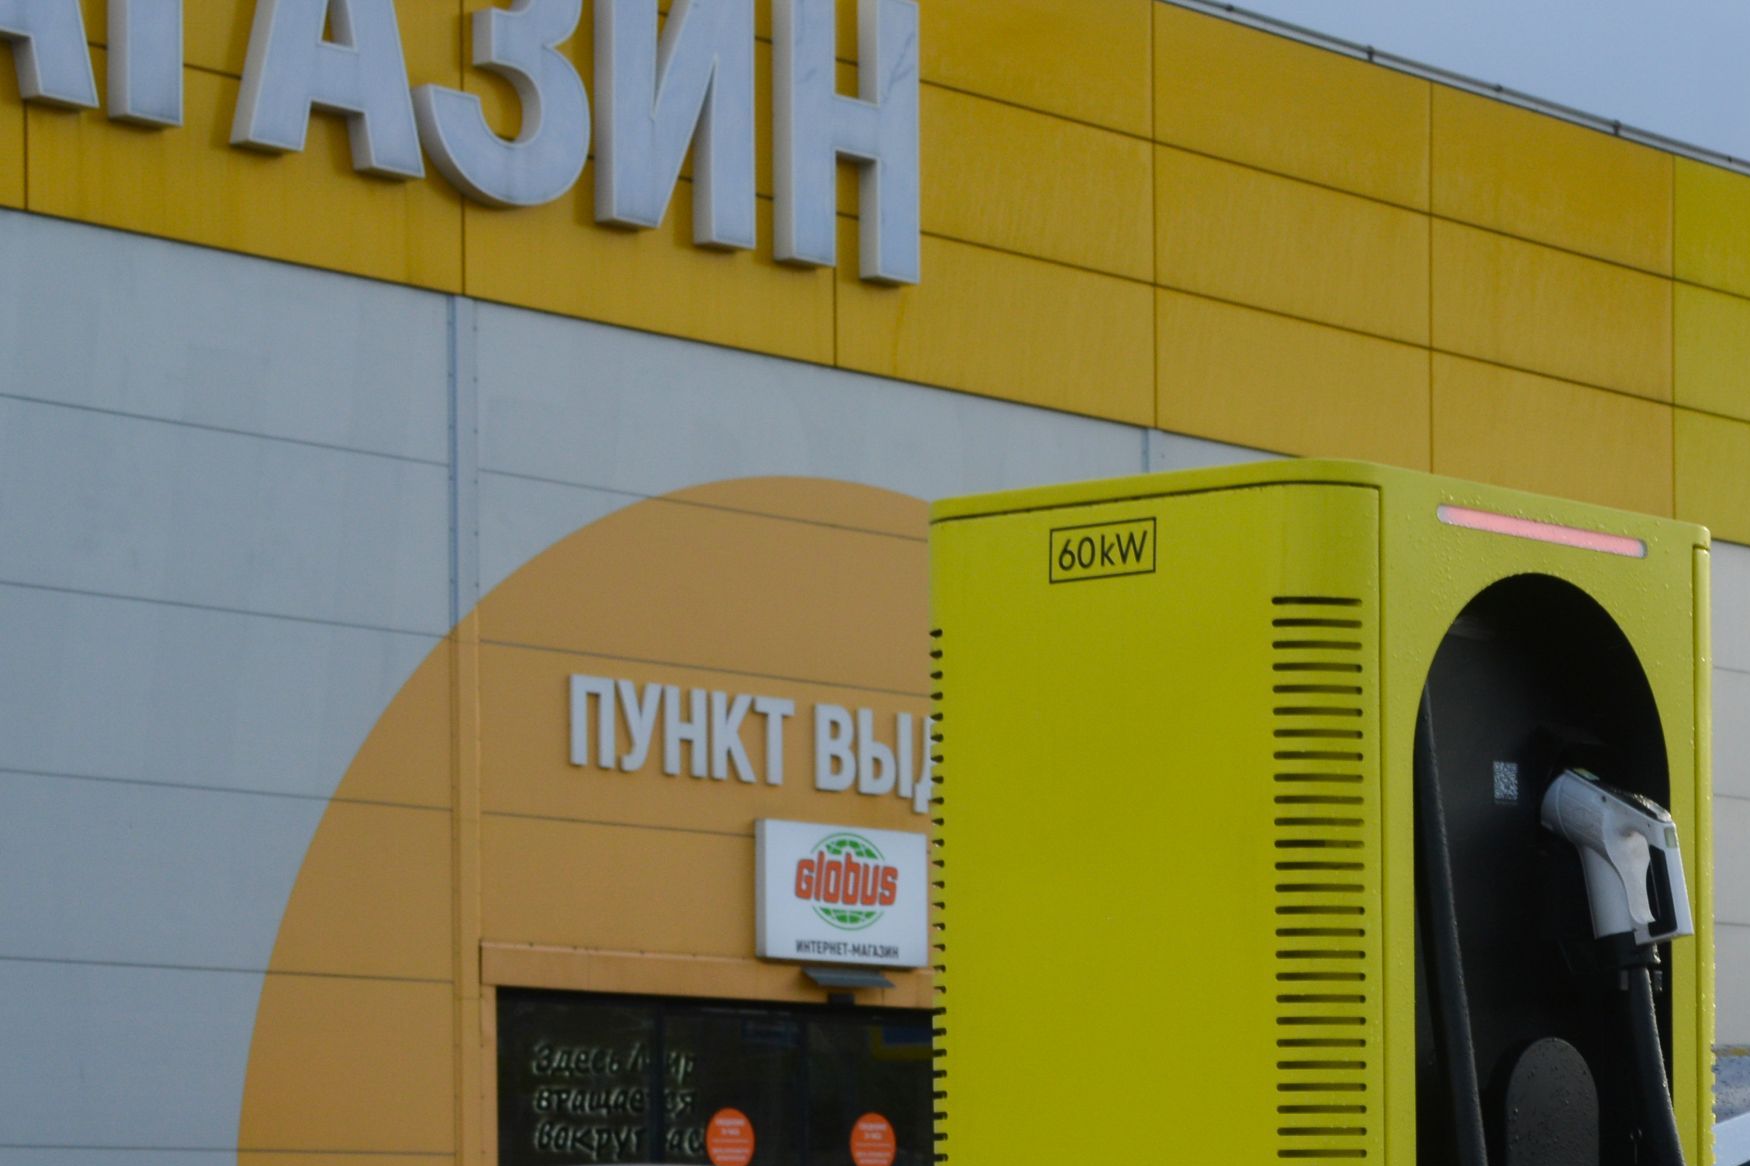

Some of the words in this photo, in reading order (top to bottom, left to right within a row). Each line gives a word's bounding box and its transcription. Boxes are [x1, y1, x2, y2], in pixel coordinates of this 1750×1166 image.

[568, 673, 796, 786] ПУНКТ
[795, 940, 900, 960] ИНТЕРНЕТ-МАГАЗИН
[532, 1041, 619, 1078] Здесь
